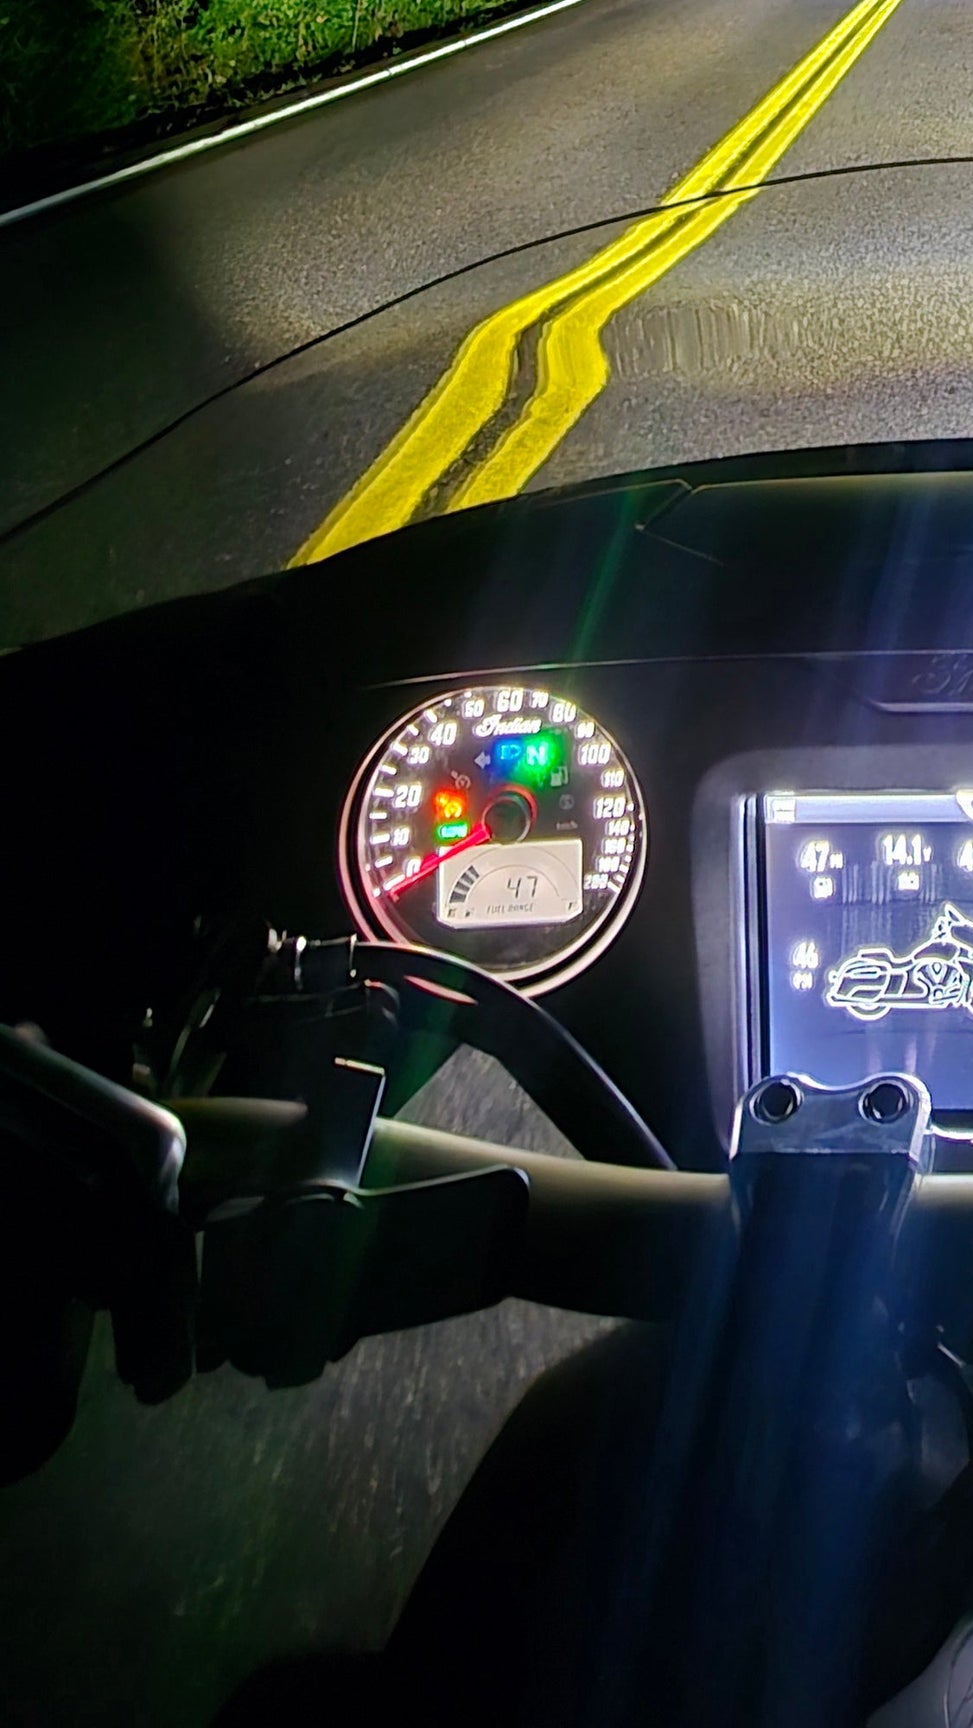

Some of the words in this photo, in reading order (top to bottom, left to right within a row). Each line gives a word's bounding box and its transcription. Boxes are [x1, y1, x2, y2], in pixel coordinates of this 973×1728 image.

[496, 691, 524, 712] 60
[531, 692, 549, 708] 70
[552, 703, 576, 722] 80
[430, 724, 457, 745] 40
[475, 715, 541, 737] Indian
[408, 746, 429, 763] 30
[527, 742, 548, 765] N
[580, 742, 611, 764] 100
[393, 784, 421, 808] 20
[594, 798, 626, 818] 120
[392, 828, 410, 847] 10
[801, 840, 830, 872] 47
[883, 834, 922, 866] 14.1
[507, 876, 538, 899] 47
